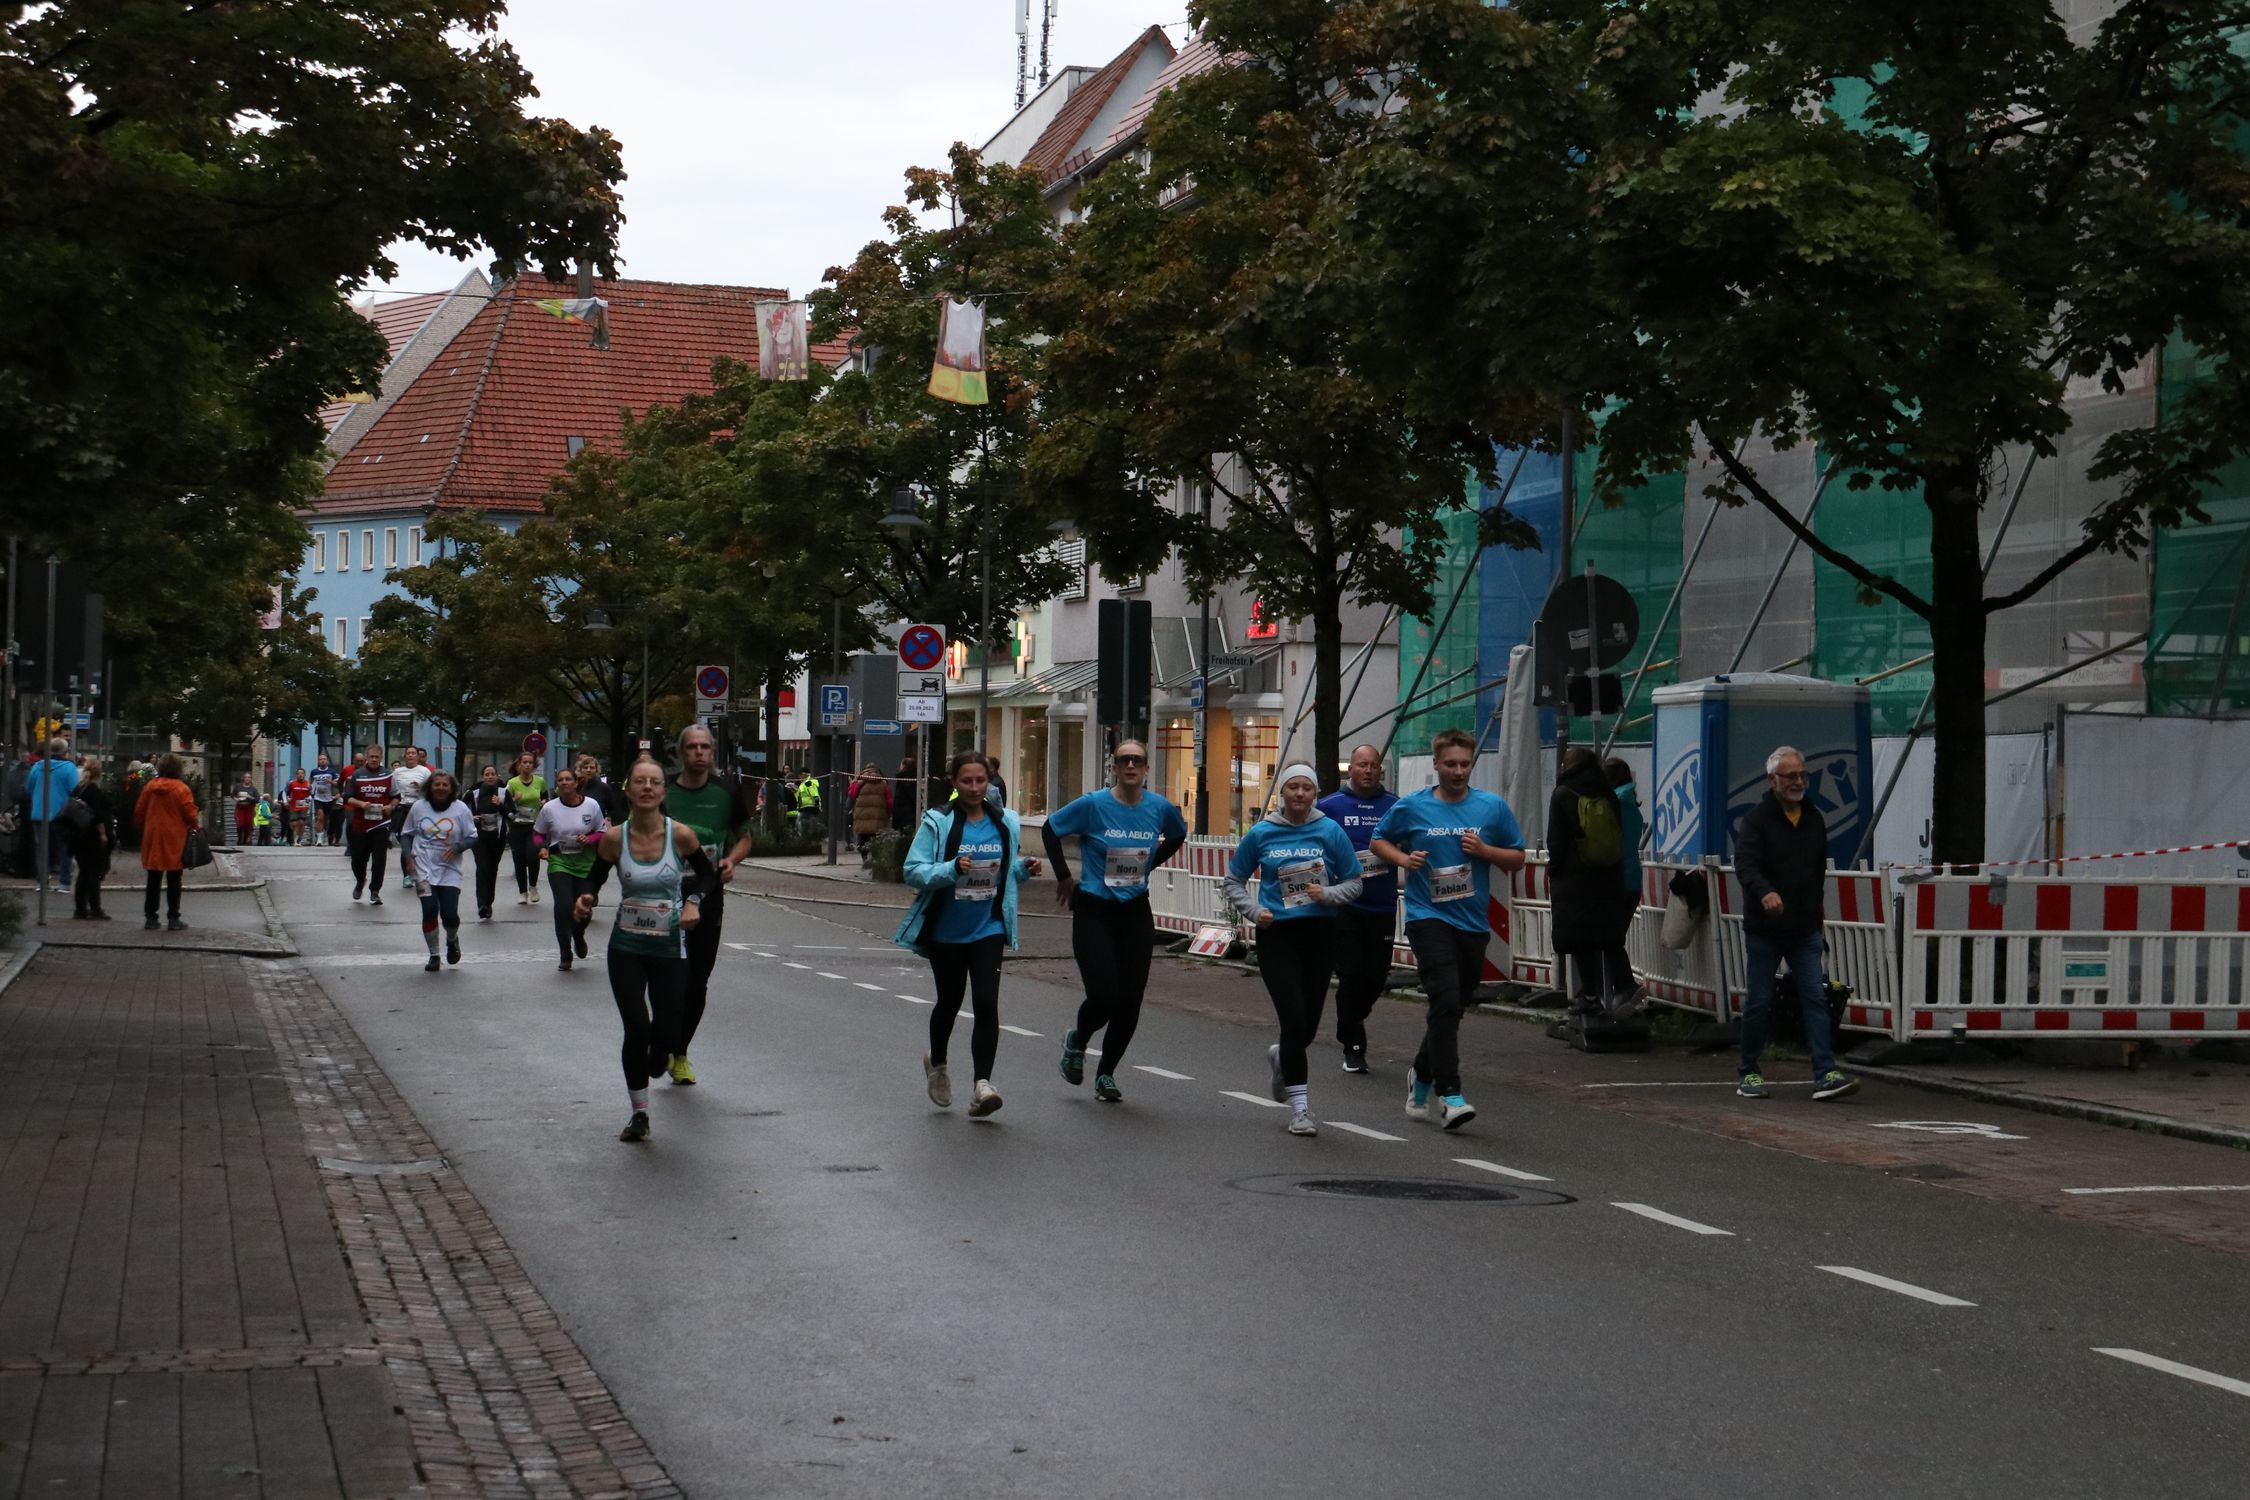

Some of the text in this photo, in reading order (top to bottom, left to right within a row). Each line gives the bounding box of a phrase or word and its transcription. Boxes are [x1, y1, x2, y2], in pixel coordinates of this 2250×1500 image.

[1211, 655, 1248, 666] Freihofstr.
[1104, 829, 1154, 840] ASSA ABLOY
[1426, 826, 1482, 836] ASSA ABOY
[1268, 848, 1324, 858] ASSA ABLOY
[1116, 864, 1138, 874] Nora
[967, 878, 990, 887] Anna
[1435, 883, 1467, 895] Fabian
[633, 917, 657, 928] Jule
